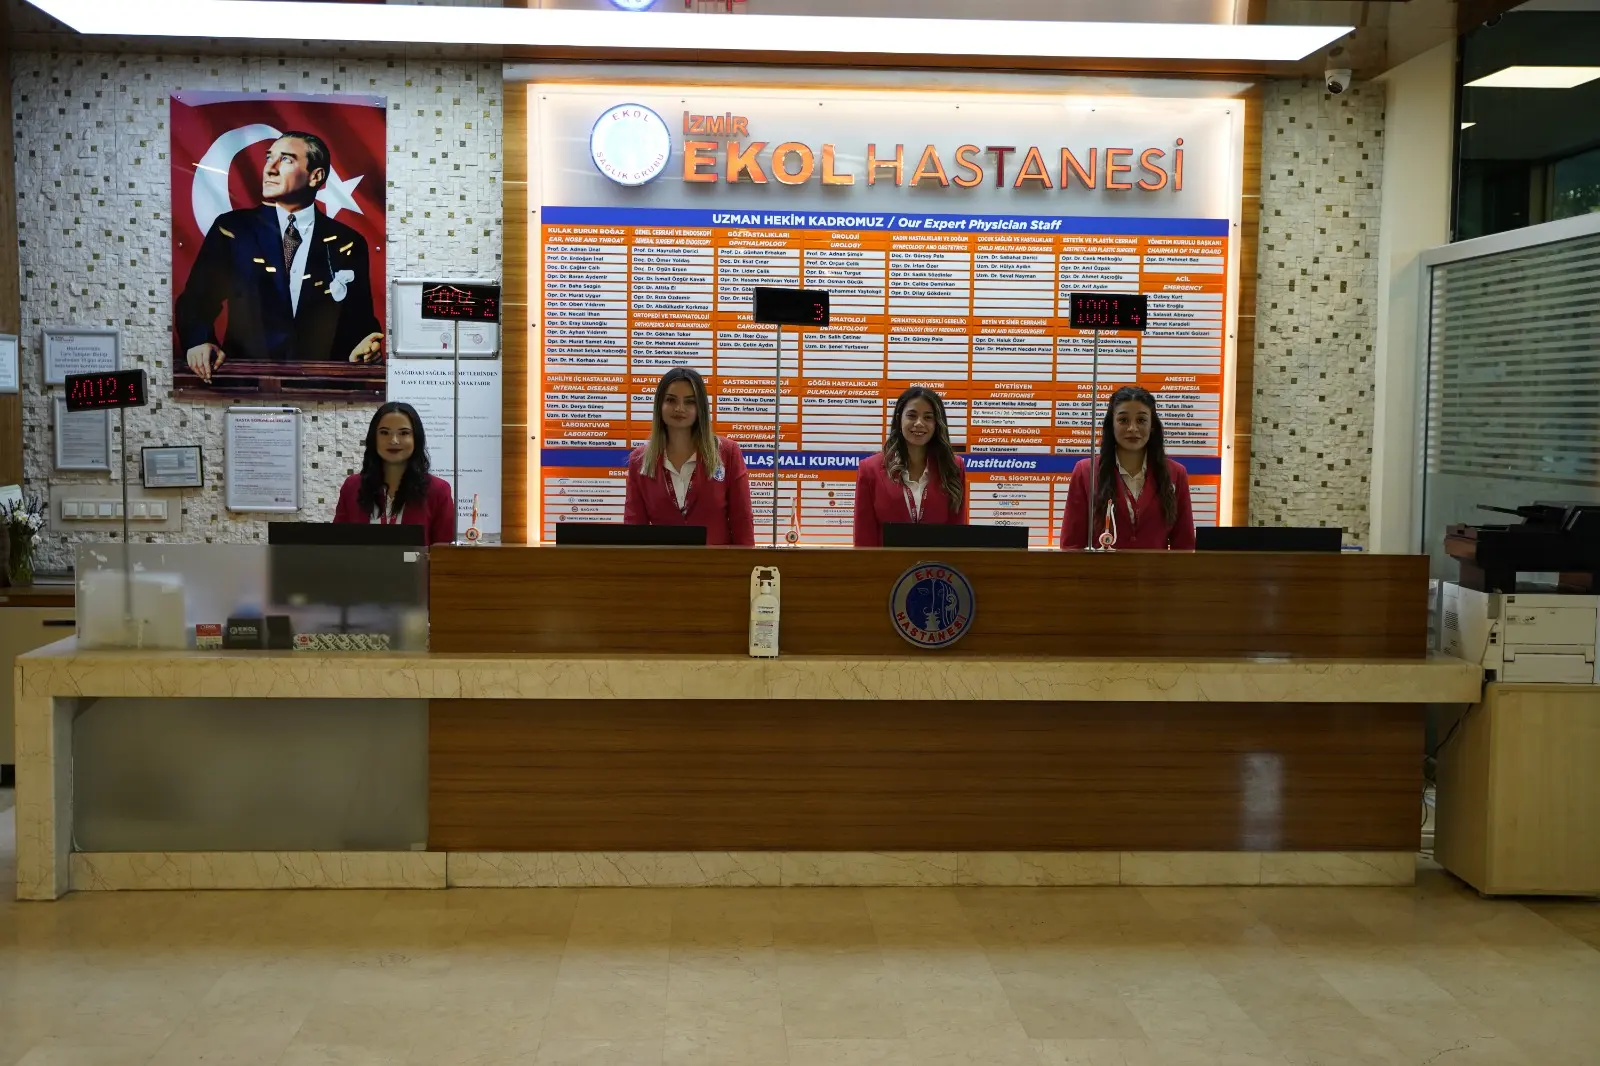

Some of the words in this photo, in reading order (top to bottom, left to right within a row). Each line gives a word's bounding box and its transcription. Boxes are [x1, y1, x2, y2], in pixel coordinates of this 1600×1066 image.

[612, 110, 649, 122] EKOL
[683, 111, 749, 136] İZMİR
[634, 154, 664, 179] GRUBU
[684, 141, 854, 185] EKOL
[868, 138, 1184, 190] HASTANESİ
[712, 214, 761, 225] UZMAN
[764, 213, 805, 226] HEKİM
[808, 216, 884, 227] KADROMUZ
[898, 218, 920, 228] Our
[924, 219, 966, 230] Expert
[969, 219, 1028, 230] Physician
[1030, 220, 1062, 230] Staff
[814, 303, 823, 320] 3
[966, 458, 1036, 468] Institutions
[915, 568, 953, 584] EKOL
[897, 611, 967, 642] HASTANESİ
